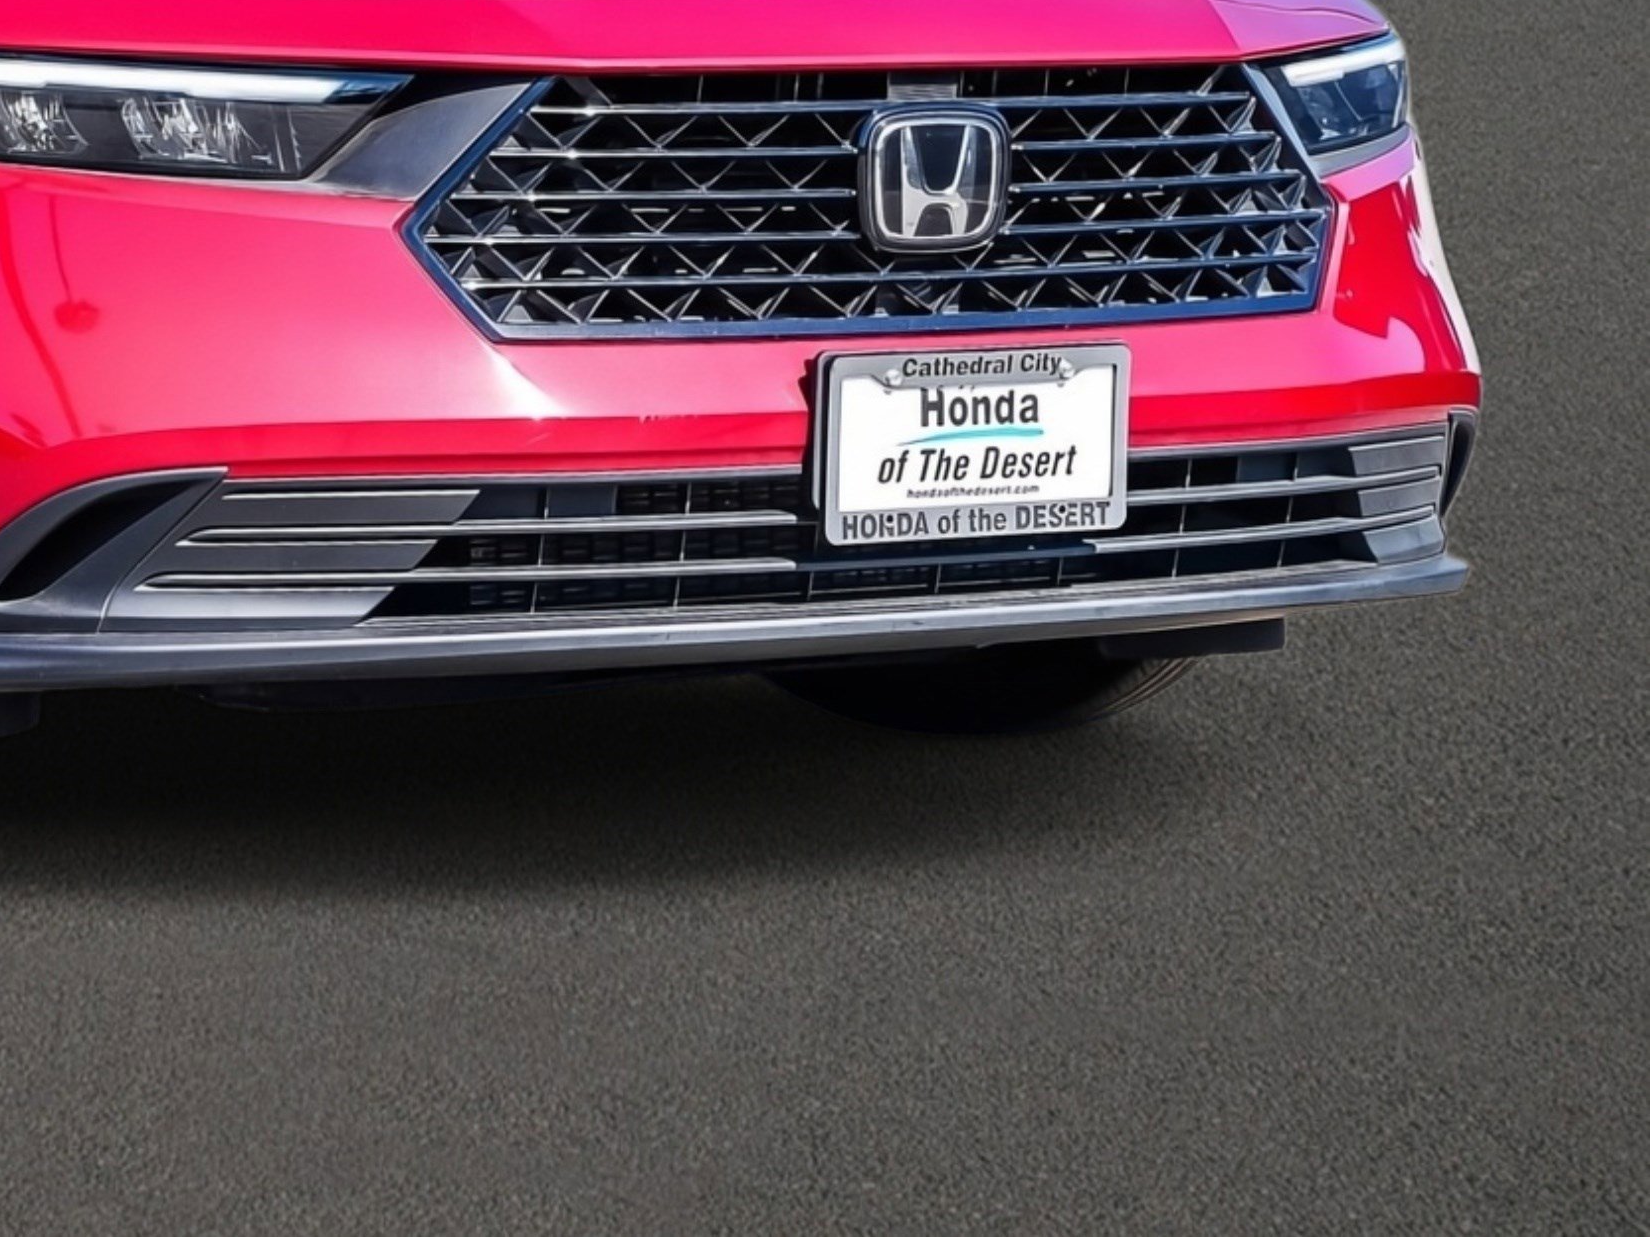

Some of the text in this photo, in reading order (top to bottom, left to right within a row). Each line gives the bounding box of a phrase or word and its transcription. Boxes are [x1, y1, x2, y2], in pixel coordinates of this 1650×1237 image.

[902, 352, 1063, 377] Cathedral City
[920, 387, 1039, 427] Honda
[878, 446, 1077, 484] of The Desert
[842, 501, 1111, 540] HONDA of the DESERT
